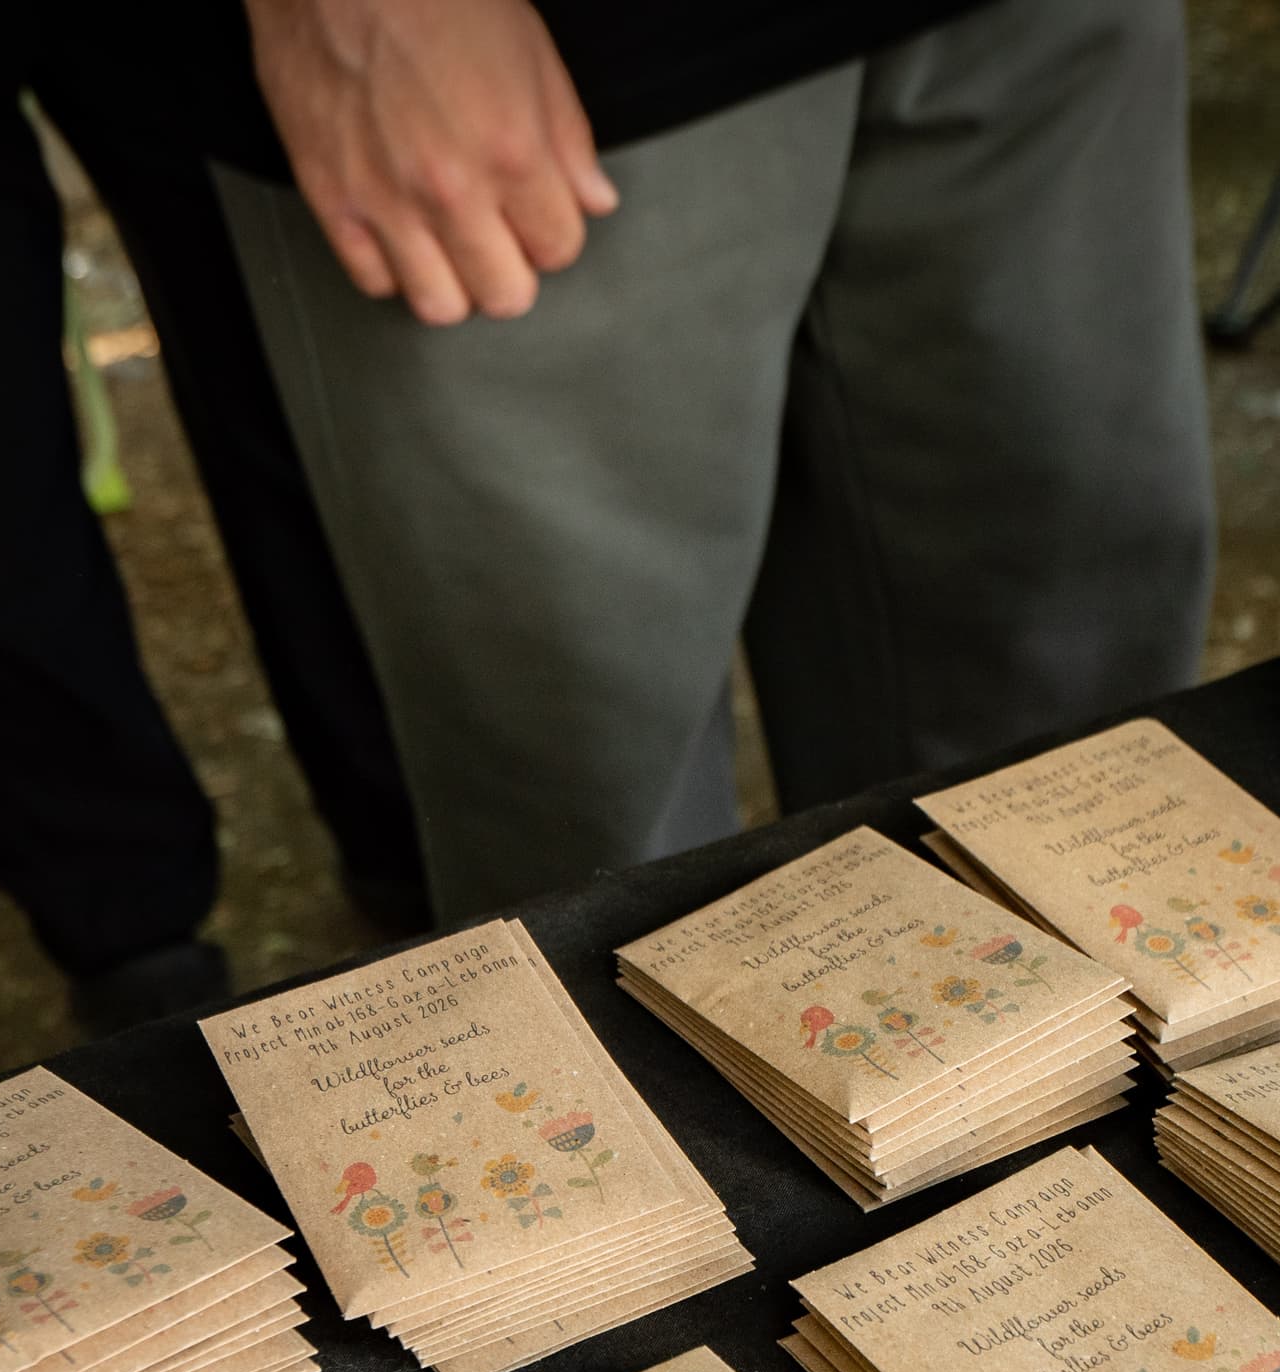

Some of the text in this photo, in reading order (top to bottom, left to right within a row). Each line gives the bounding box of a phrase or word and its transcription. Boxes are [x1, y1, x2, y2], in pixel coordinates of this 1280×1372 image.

[740, 894, 892, 968] Wildflower seeds
[230, 944, 488, 1038] We Bear Witness Campaign
[223, 1035, 287, 1064] Project
[307, 994, 458, 1055] 9th August 2026
[310, 1021, 490, 1091] Wildflower seeds
[339, 1067, 509, 1134] butterflies & bees
[382, 1061, 450, 1098] for the
[11, 1190, 32, 1203] &
[32, 1170, 81, 1191] bees
[832, 1178, 1074, 1299] We Bear Witness Campaign
[931, 1238, 1073, 1316] 9th August 2026
[840, 1294, 906, 1329] Project
[957, 1267, 1127, 1356] Wildflower seeds
[1035, 1317, 1105, 1360] for the
[1105, 1334, 1129, 1352] &
[1122, 1315, 1174, 1338] bees
